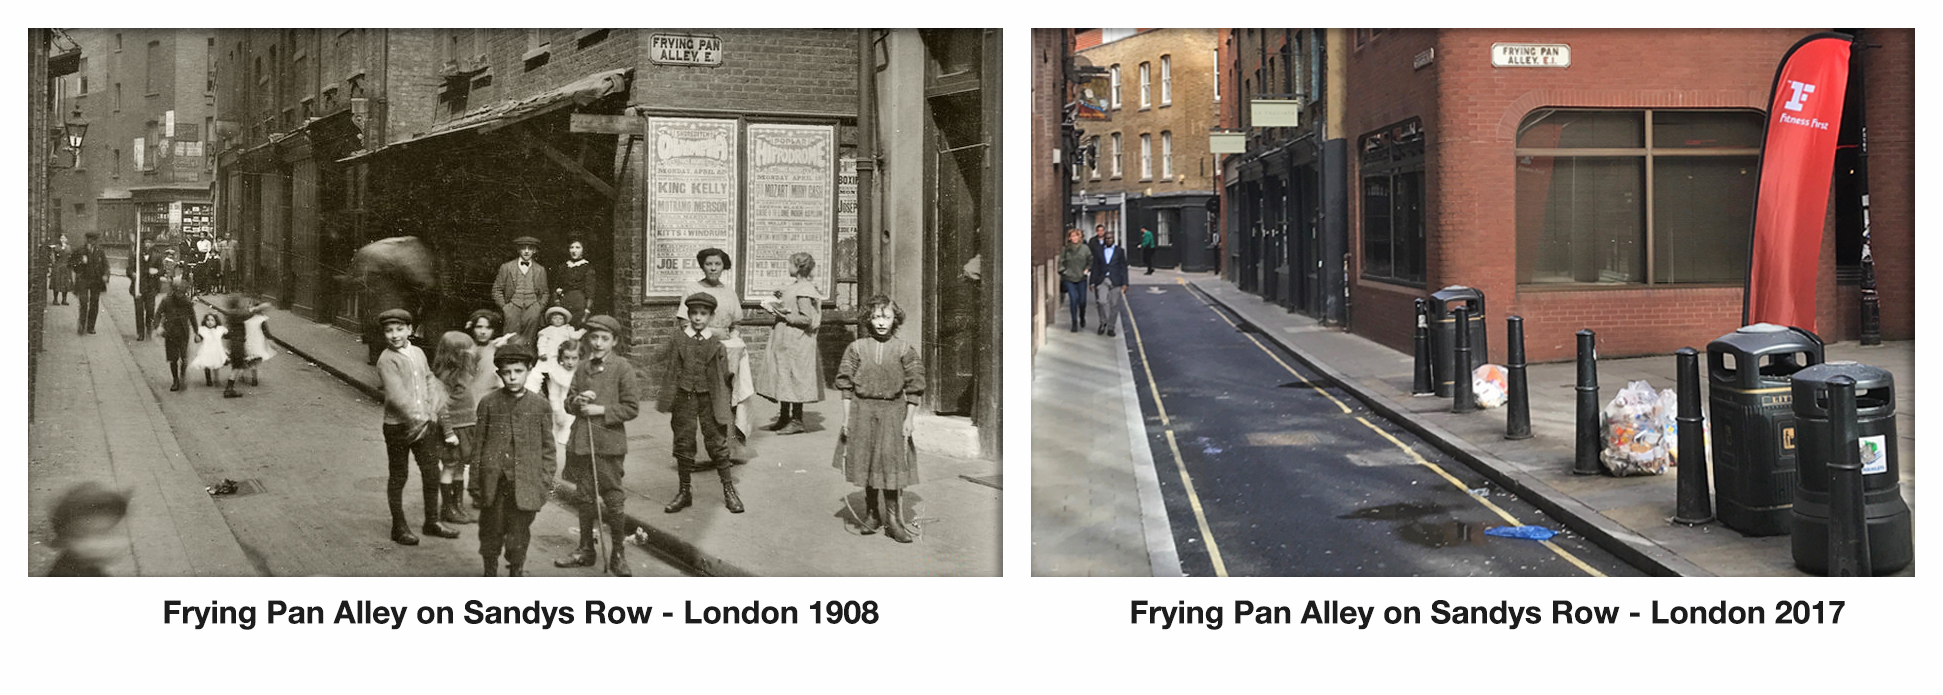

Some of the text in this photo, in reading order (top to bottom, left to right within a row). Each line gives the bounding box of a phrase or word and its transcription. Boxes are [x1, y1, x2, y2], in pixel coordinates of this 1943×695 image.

[653, 37, 720, 51] FRYING PAN
[704, 52, 714, 62] E.
[1503, 46, 1559, 56] FRYING PAN
[1779, 112, 1829, 131] Fitness First
[756, 139, 826, 167] HIPPODROME
[658, 181, 728, 195] KING KELLY
[657, 229, 682, 237] KITTS
[656, 258, 679, 270] JOE
